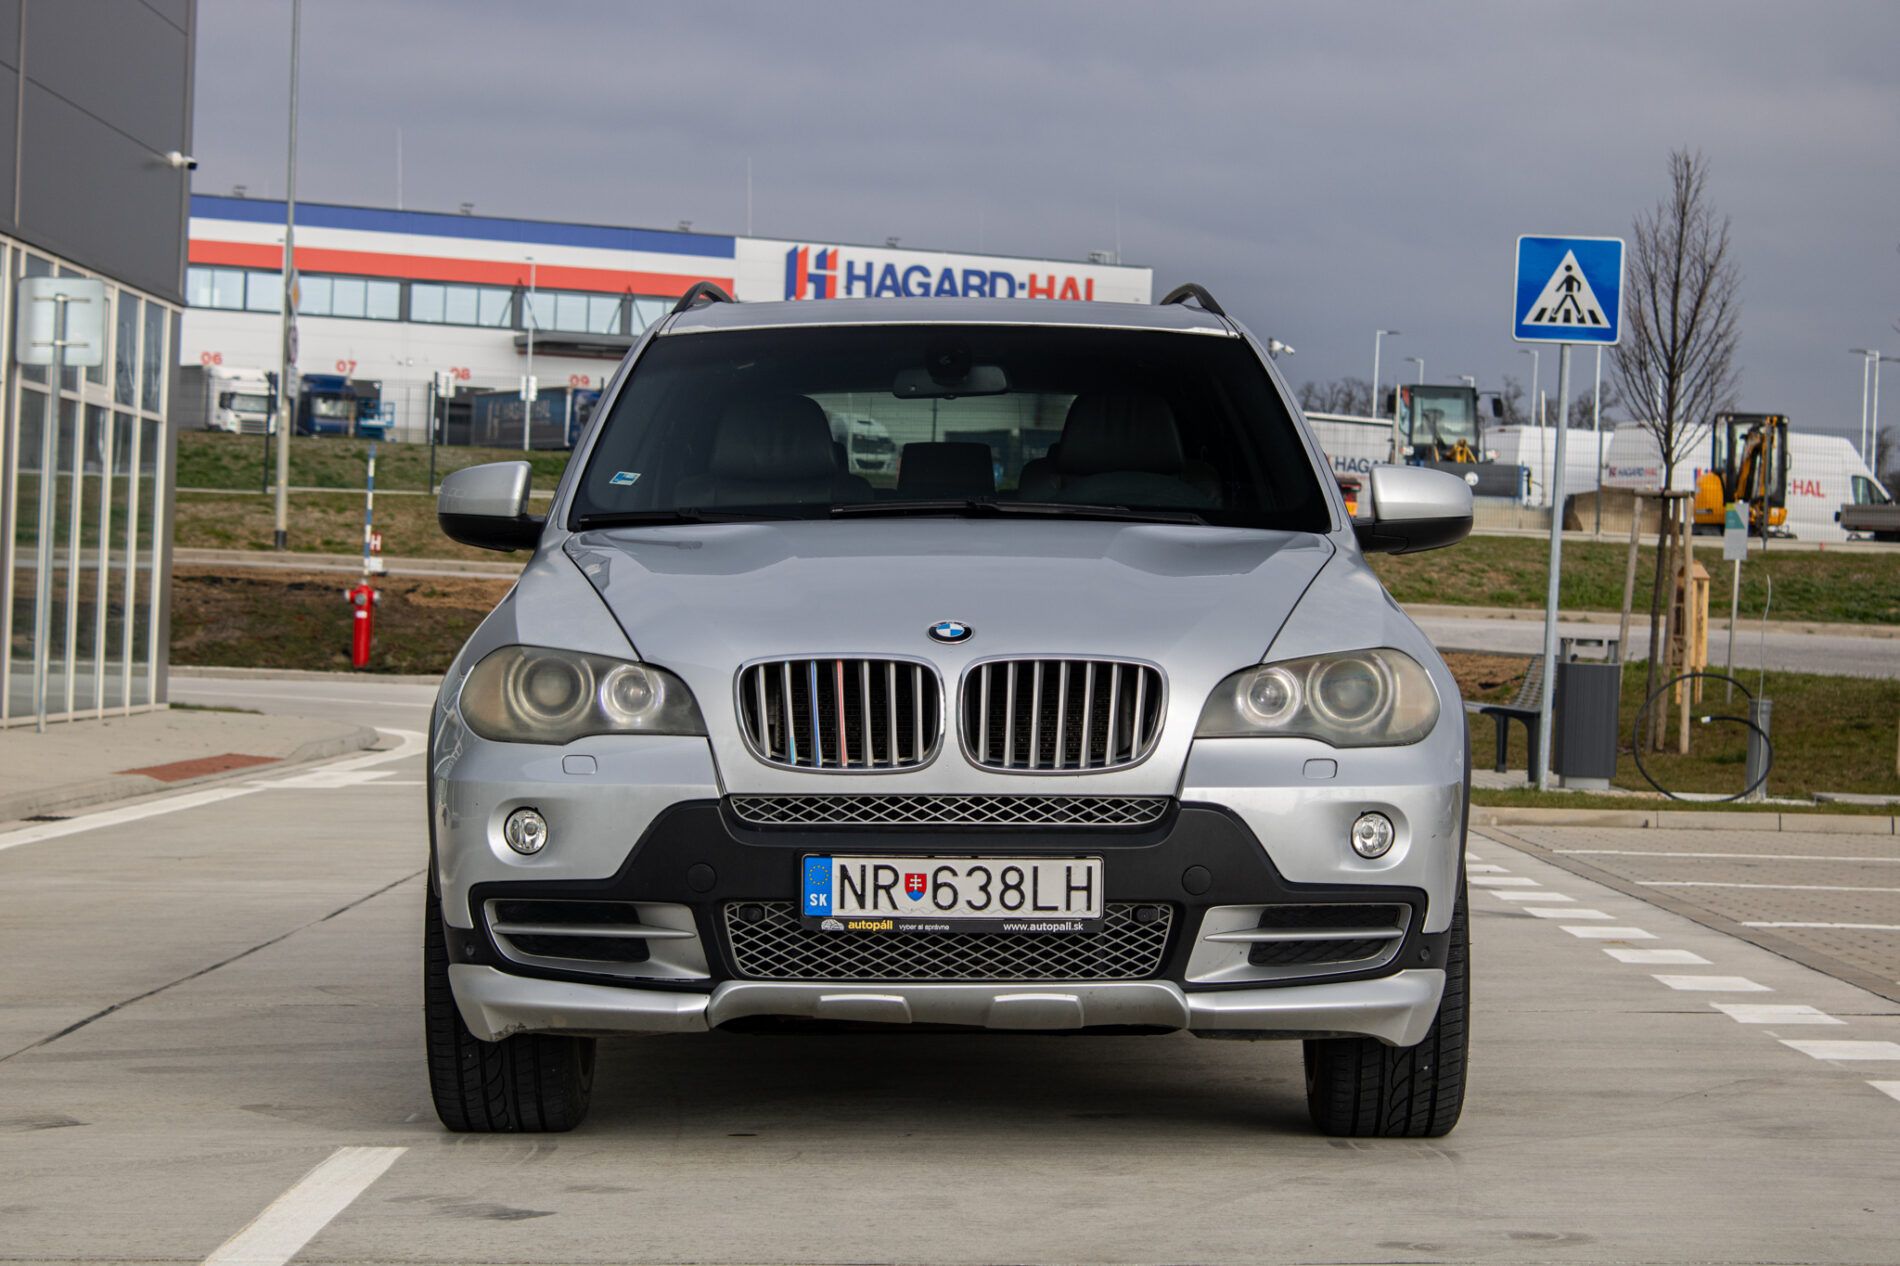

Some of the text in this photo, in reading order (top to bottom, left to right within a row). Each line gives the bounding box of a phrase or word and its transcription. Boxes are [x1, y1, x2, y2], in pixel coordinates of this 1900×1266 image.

[335, 360, 357, 374] 07
[1335, 456, 1388, 474] HAG
[370, 534, 382, 551] H
[839, 864, 1093, 912] NR 638LH
[809, 893, 828, 906] SK
[1003, 921, 1084, 932] www.autopall.sk
